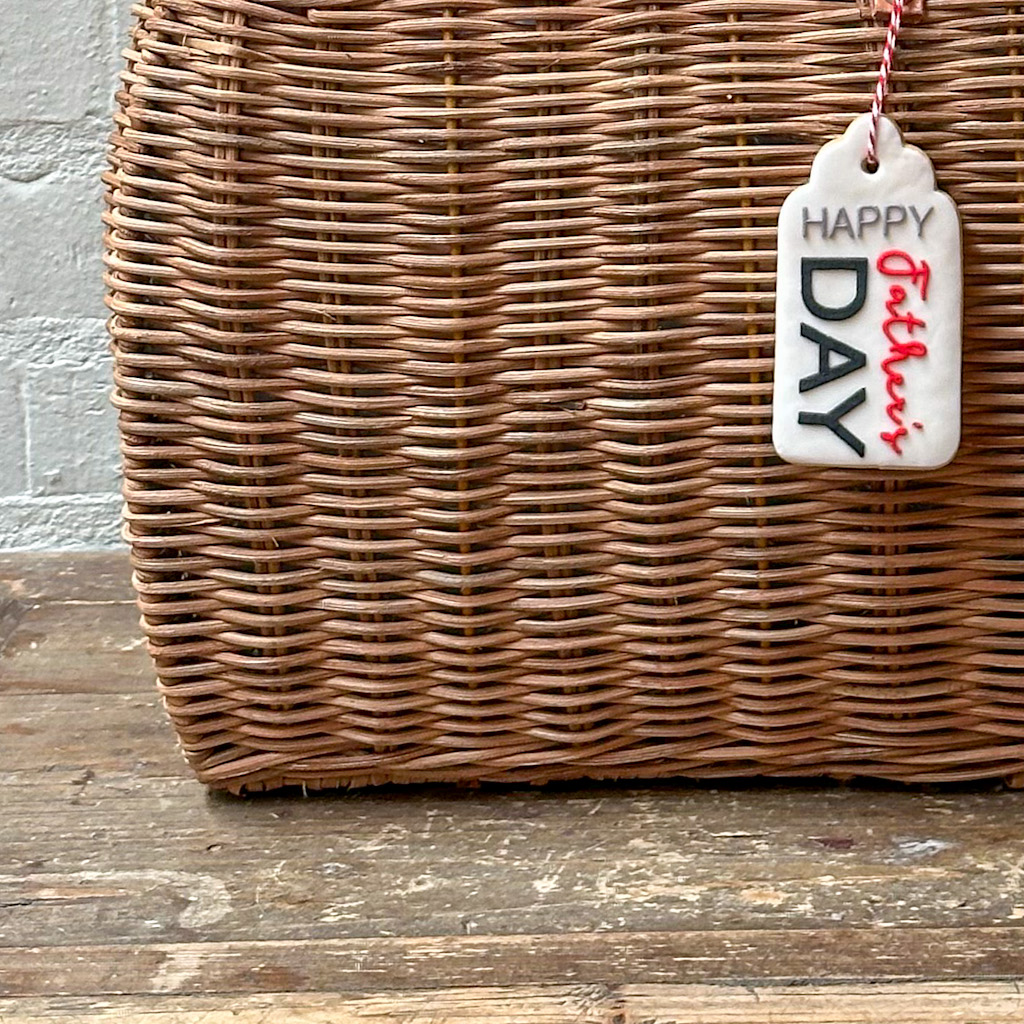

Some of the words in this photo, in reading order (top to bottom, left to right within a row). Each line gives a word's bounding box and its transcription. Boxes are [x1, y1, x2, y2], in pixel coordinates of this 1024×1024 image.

[802, 205, 935, 241] HAPPY
[798, 257, 869, 458] DAY
[876, 249, 932, 457] Father's
